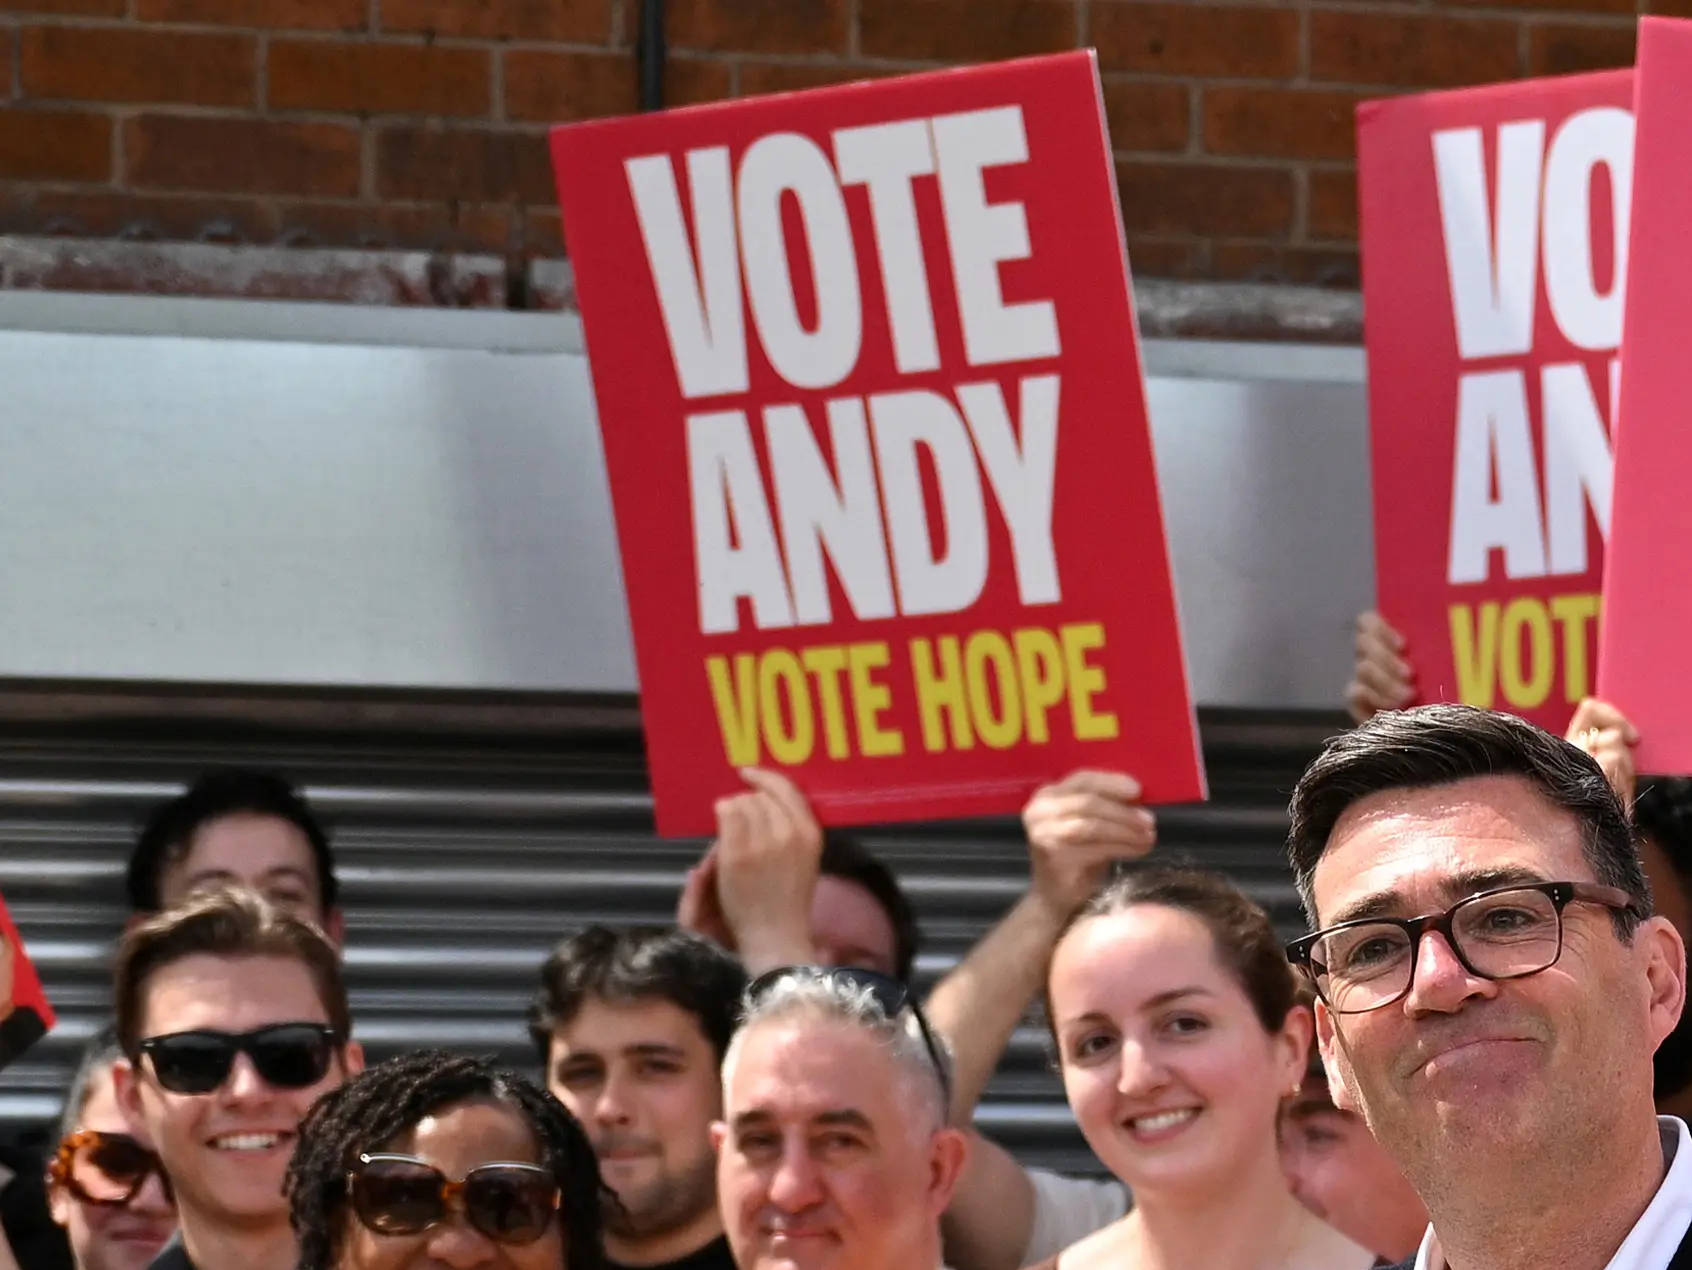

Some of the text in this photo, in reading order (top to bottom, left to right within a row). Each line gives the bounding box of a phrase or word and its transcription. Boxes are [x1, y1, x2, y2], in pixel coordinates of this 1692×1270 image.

[624, 104, 1061, 398] VOTE
[684, 374, 1062, 634] ANDY
[705, 623, 1119, 768] VOTE HOPE
